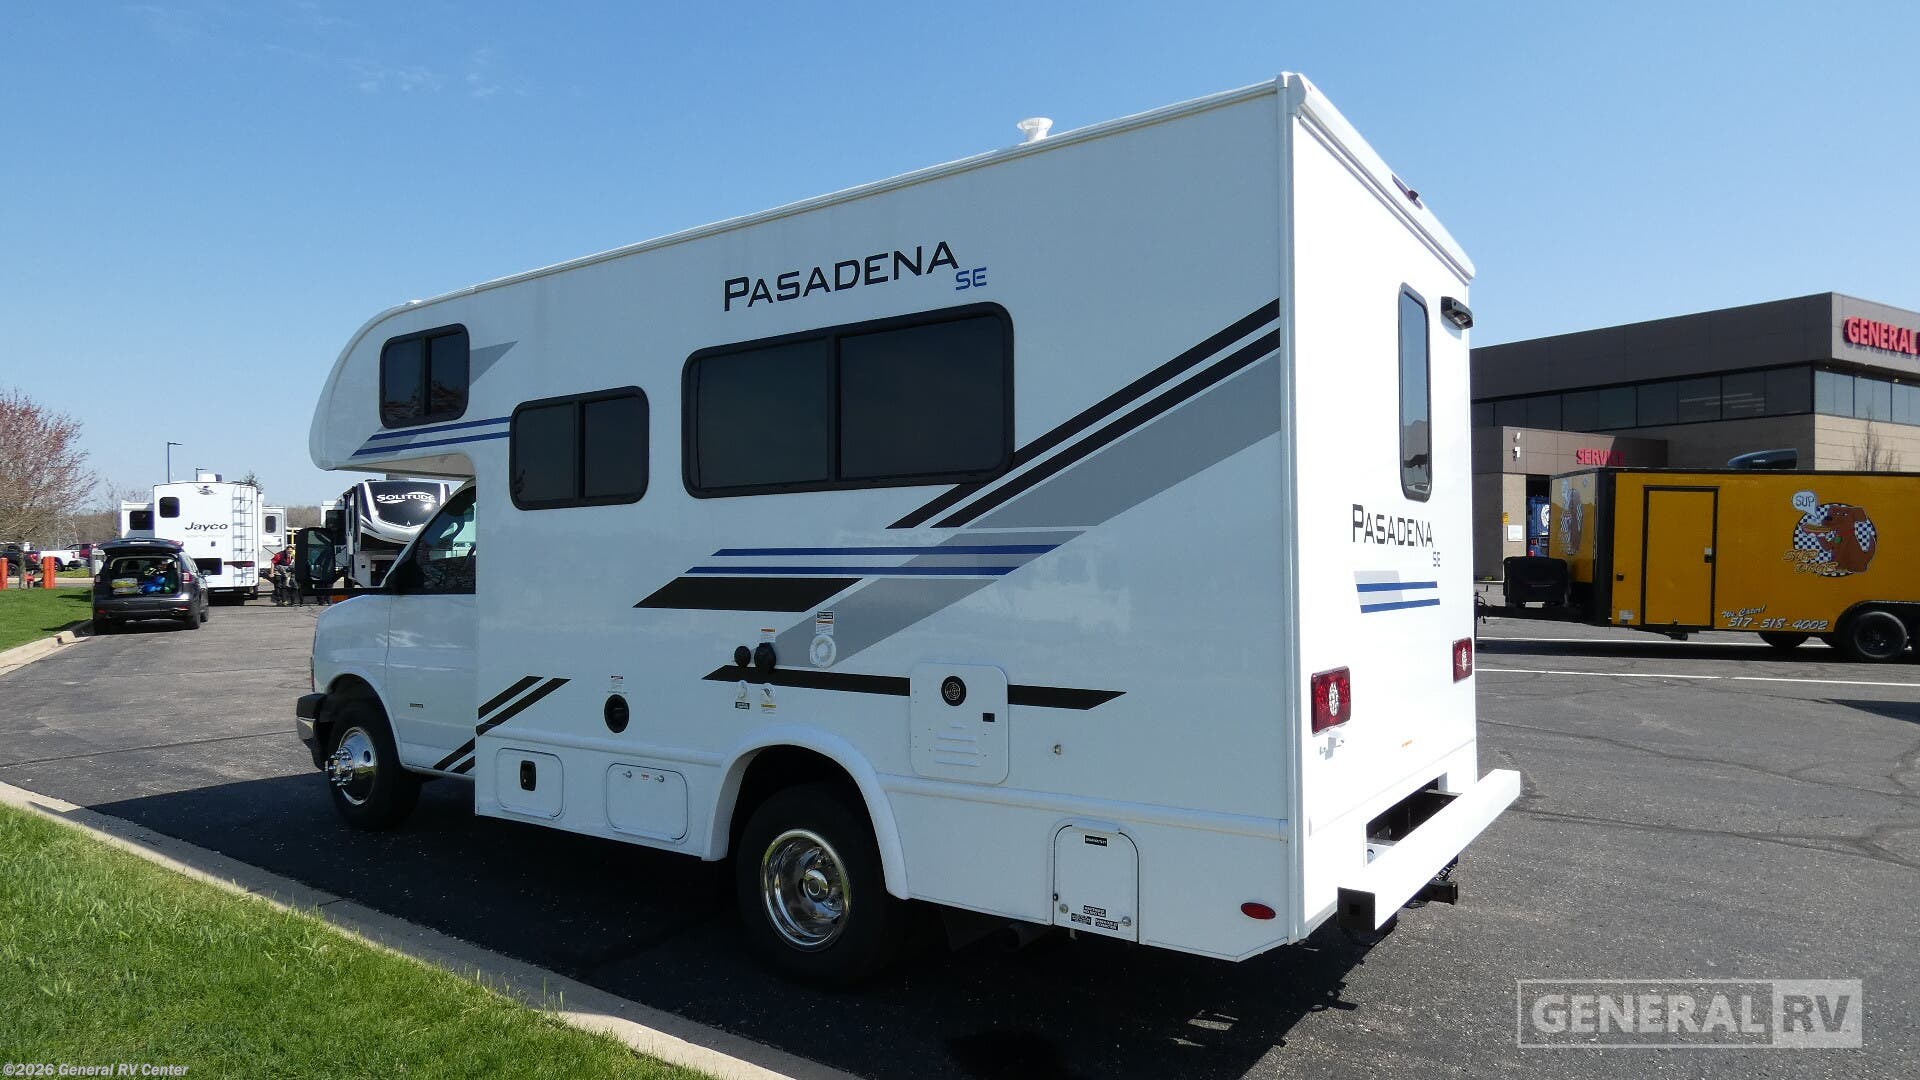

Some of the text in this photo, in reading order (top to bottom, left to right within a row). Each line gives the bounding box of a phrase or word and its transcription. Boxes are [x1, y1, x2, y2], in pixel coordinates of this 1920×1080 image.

[723, 240, 960, 312] PASADENA
[954, 266, 988, 291] SE
[1844, 315, 1918, 355] GENERAL
[376, 492, 437, 504] SOLITUDE
[1795, 495, 1816, 508] SUP
[184, 521, 229, 532] Jayco
[1352, 504, 1434, 548] PASADENA
[1728, 617, 1829, 630] 517-518-4002
